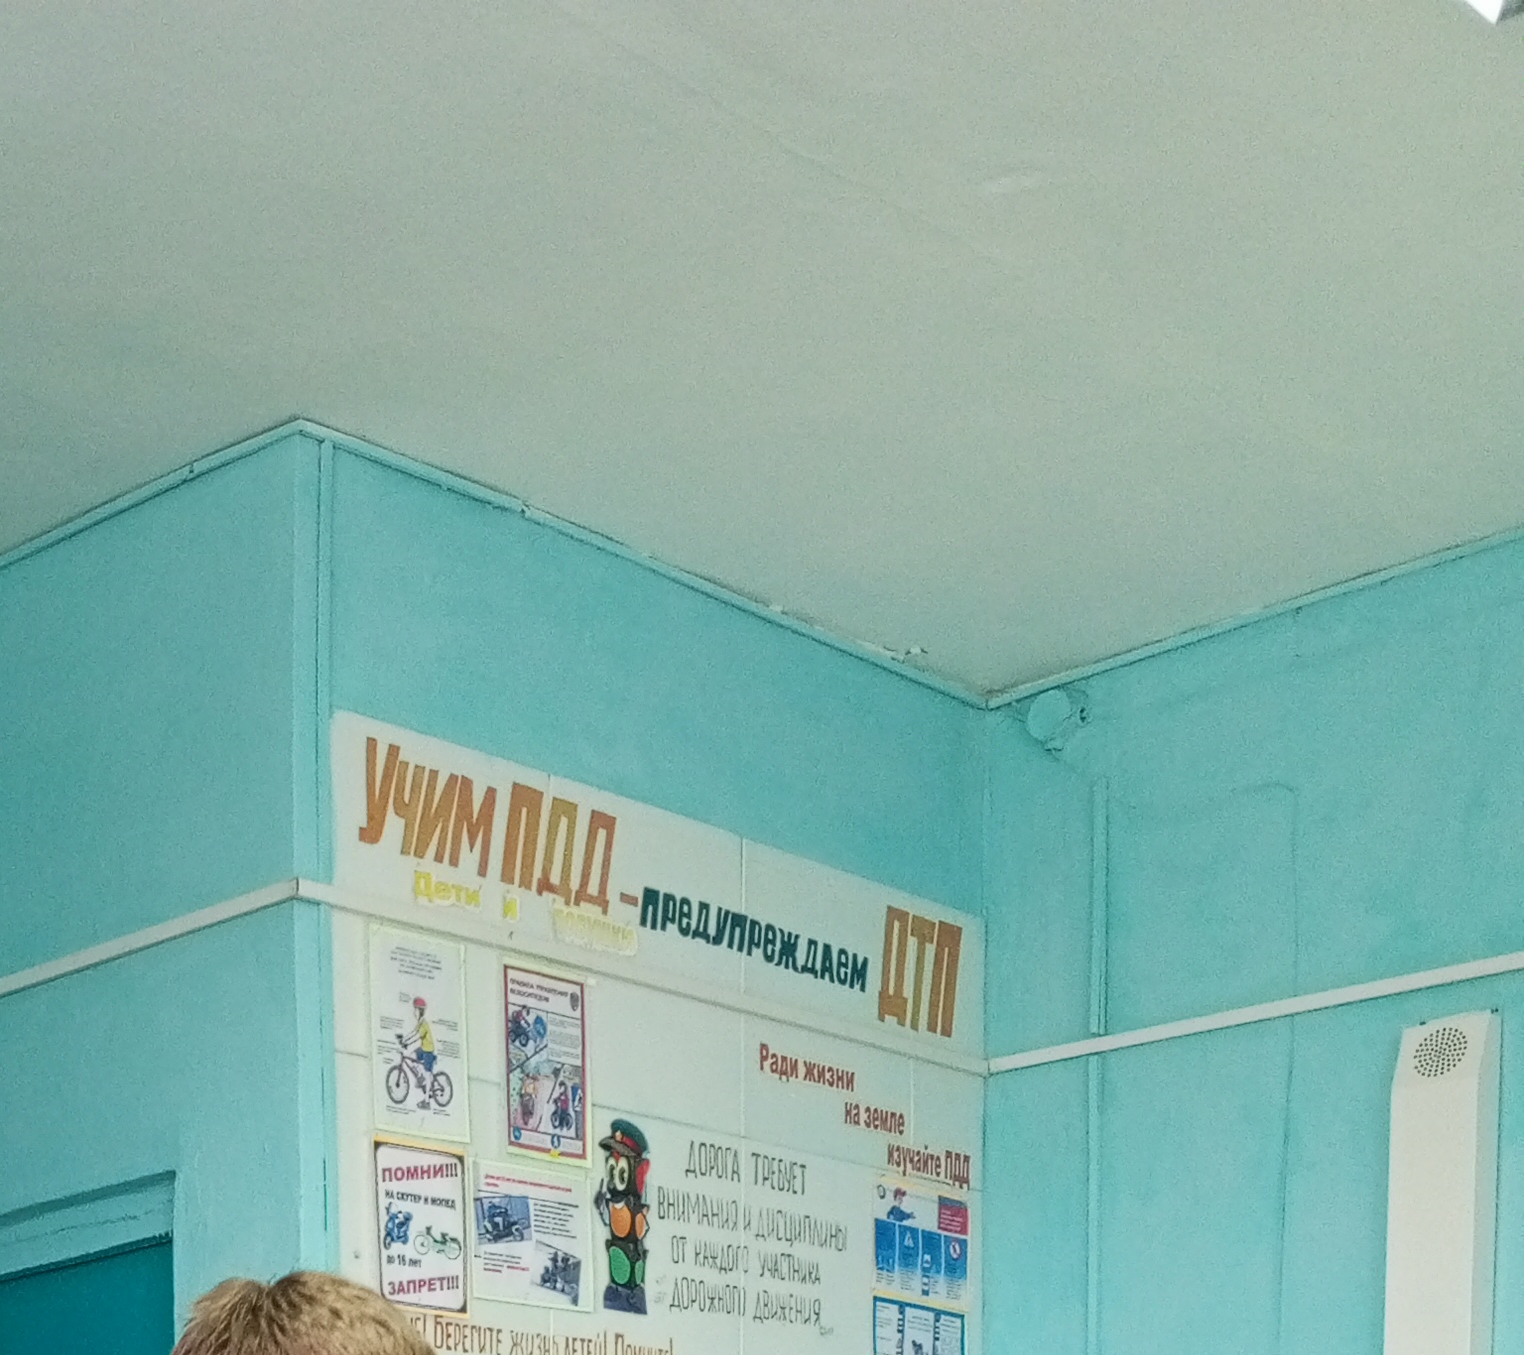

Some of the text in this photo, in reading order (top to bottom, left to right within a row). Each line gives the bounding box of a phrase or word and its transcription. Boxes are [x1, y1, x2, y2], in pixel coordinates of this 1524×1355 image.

[359, 736, 497, 878] УЧИМ
[501, 782, 617, 915] ПДД
[877, 904, 963, 1038] ДТП
[414, 870, 480, 906] Дети
[760, 1043, 855, 1092] Ради жизни
[845, 1102, 905, 1135] на земле
[382, 1163, 458, 1182] ПОМНИ!!!
[685, 1141, 806, 1195] ДОРОГА ТРЕБУЕТ
[887, 1143, 970, 1190] изучайте ПДД
[385, 1190, 455, 1210] НА СКУТЕР И МОПЕД
[658, 1186, 738, 1231] ВНИМАНИЯ
[755, 1208, 847, 1251] ДИСЦИПЛИНЫ
[397, 1255, 406, 1266] 16
[672, 1235, 821, 1284] ОТ КАЖДОГО УЧАСТНИКА
[388, 1276, 459, 1295] ЗАПРЕТ!!!
[670, 1278, 821, 1326] ДОРОЖНОГО ДВИЖЕНИЯ
